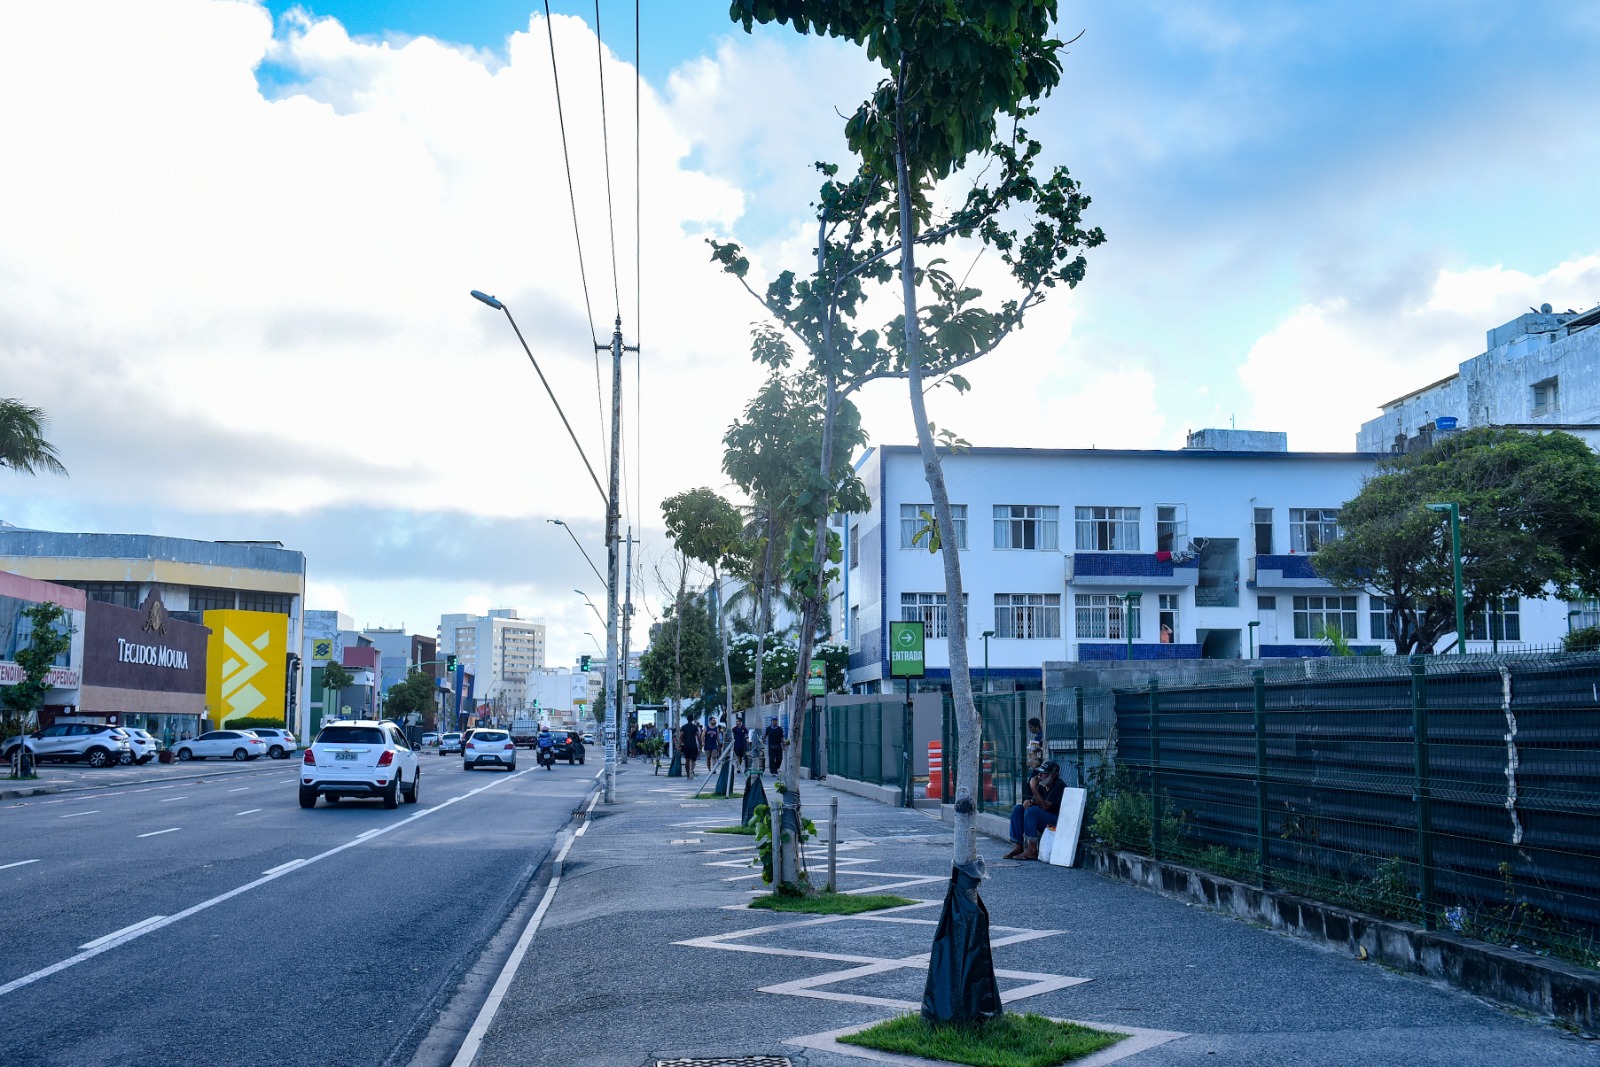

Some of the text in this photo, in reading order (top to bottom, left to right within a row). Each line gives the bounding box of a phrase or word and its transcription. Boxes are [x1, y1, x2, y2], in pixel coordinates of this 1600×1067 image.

[117, 637, 189, 670] TECIDOS MOURA
[892, 650, 923, 662] ENTRADA
